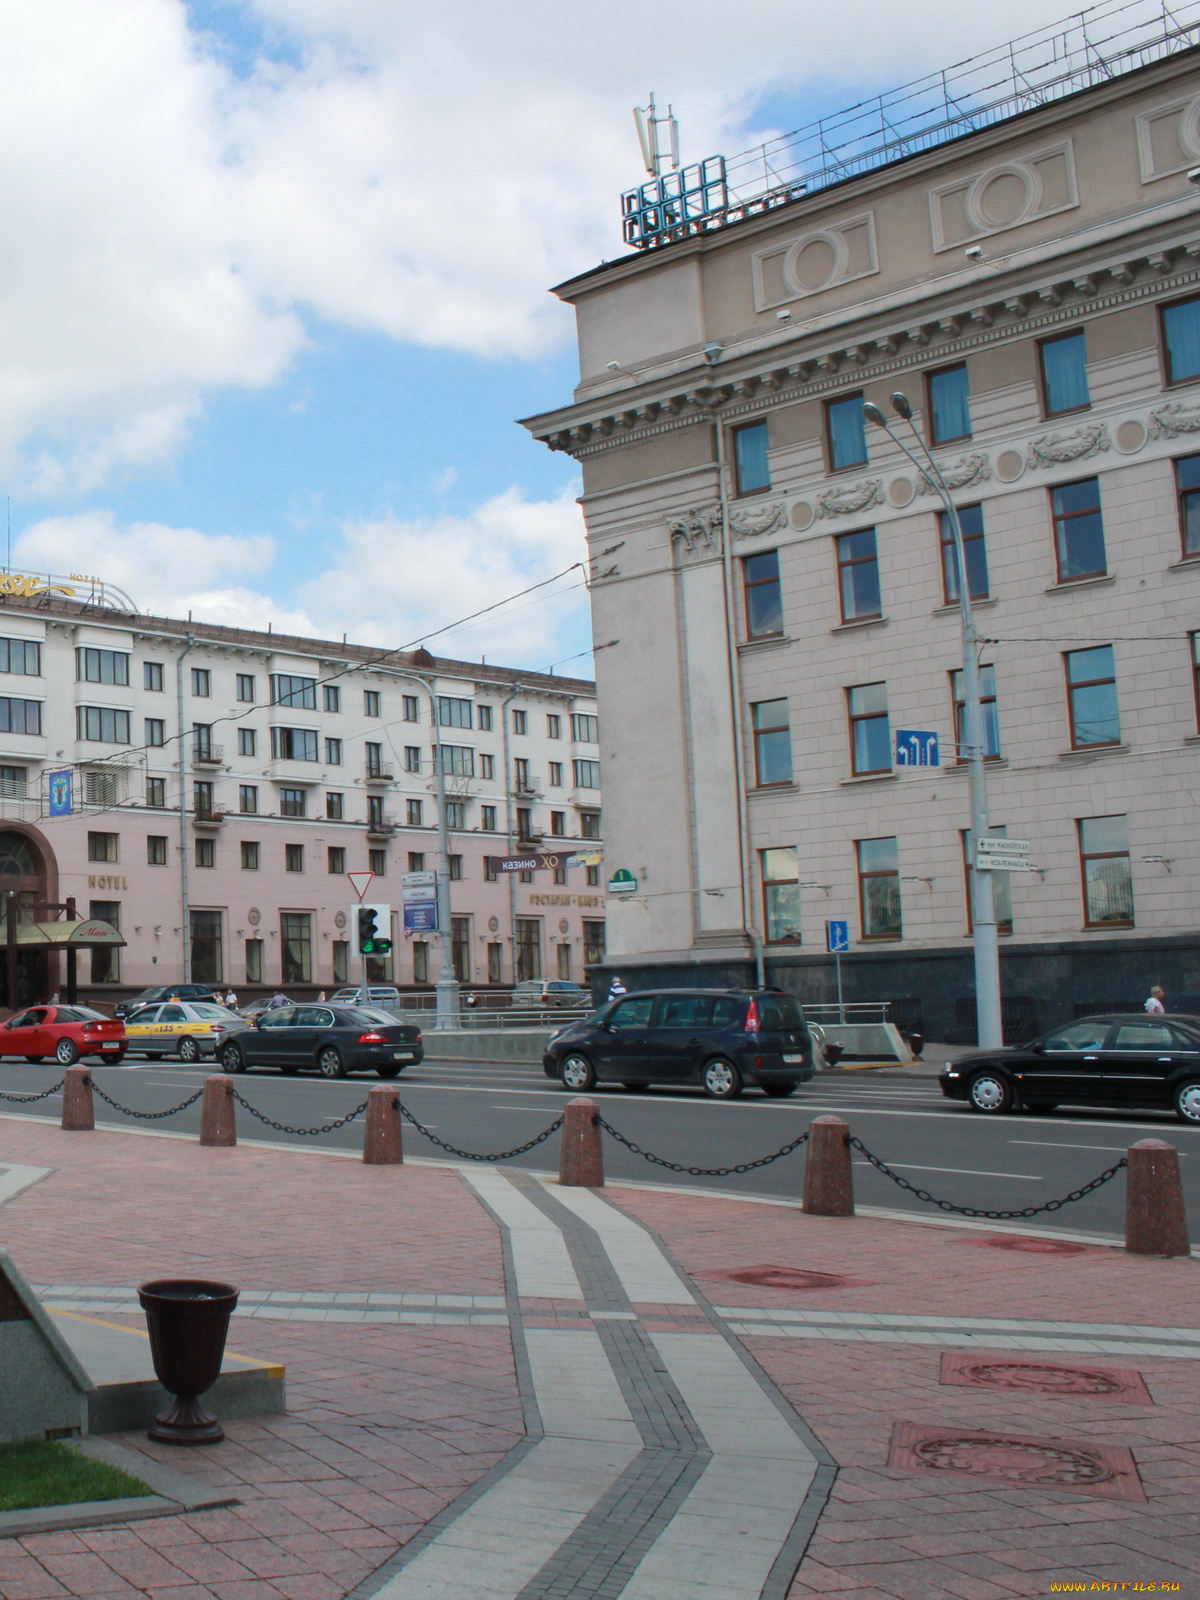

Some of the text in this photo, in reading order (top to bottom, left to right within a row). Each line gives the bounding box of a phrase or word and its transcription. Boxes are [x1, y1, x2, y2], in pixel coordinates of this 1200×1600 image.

[69, 572, 100, 584] HOTEL
[502, 859, 537, 870] казино
[619, 871, 625, 881] 1
[88, 874, 128, 890] HOTEL
[159, 1024, 174, 1033] 135
